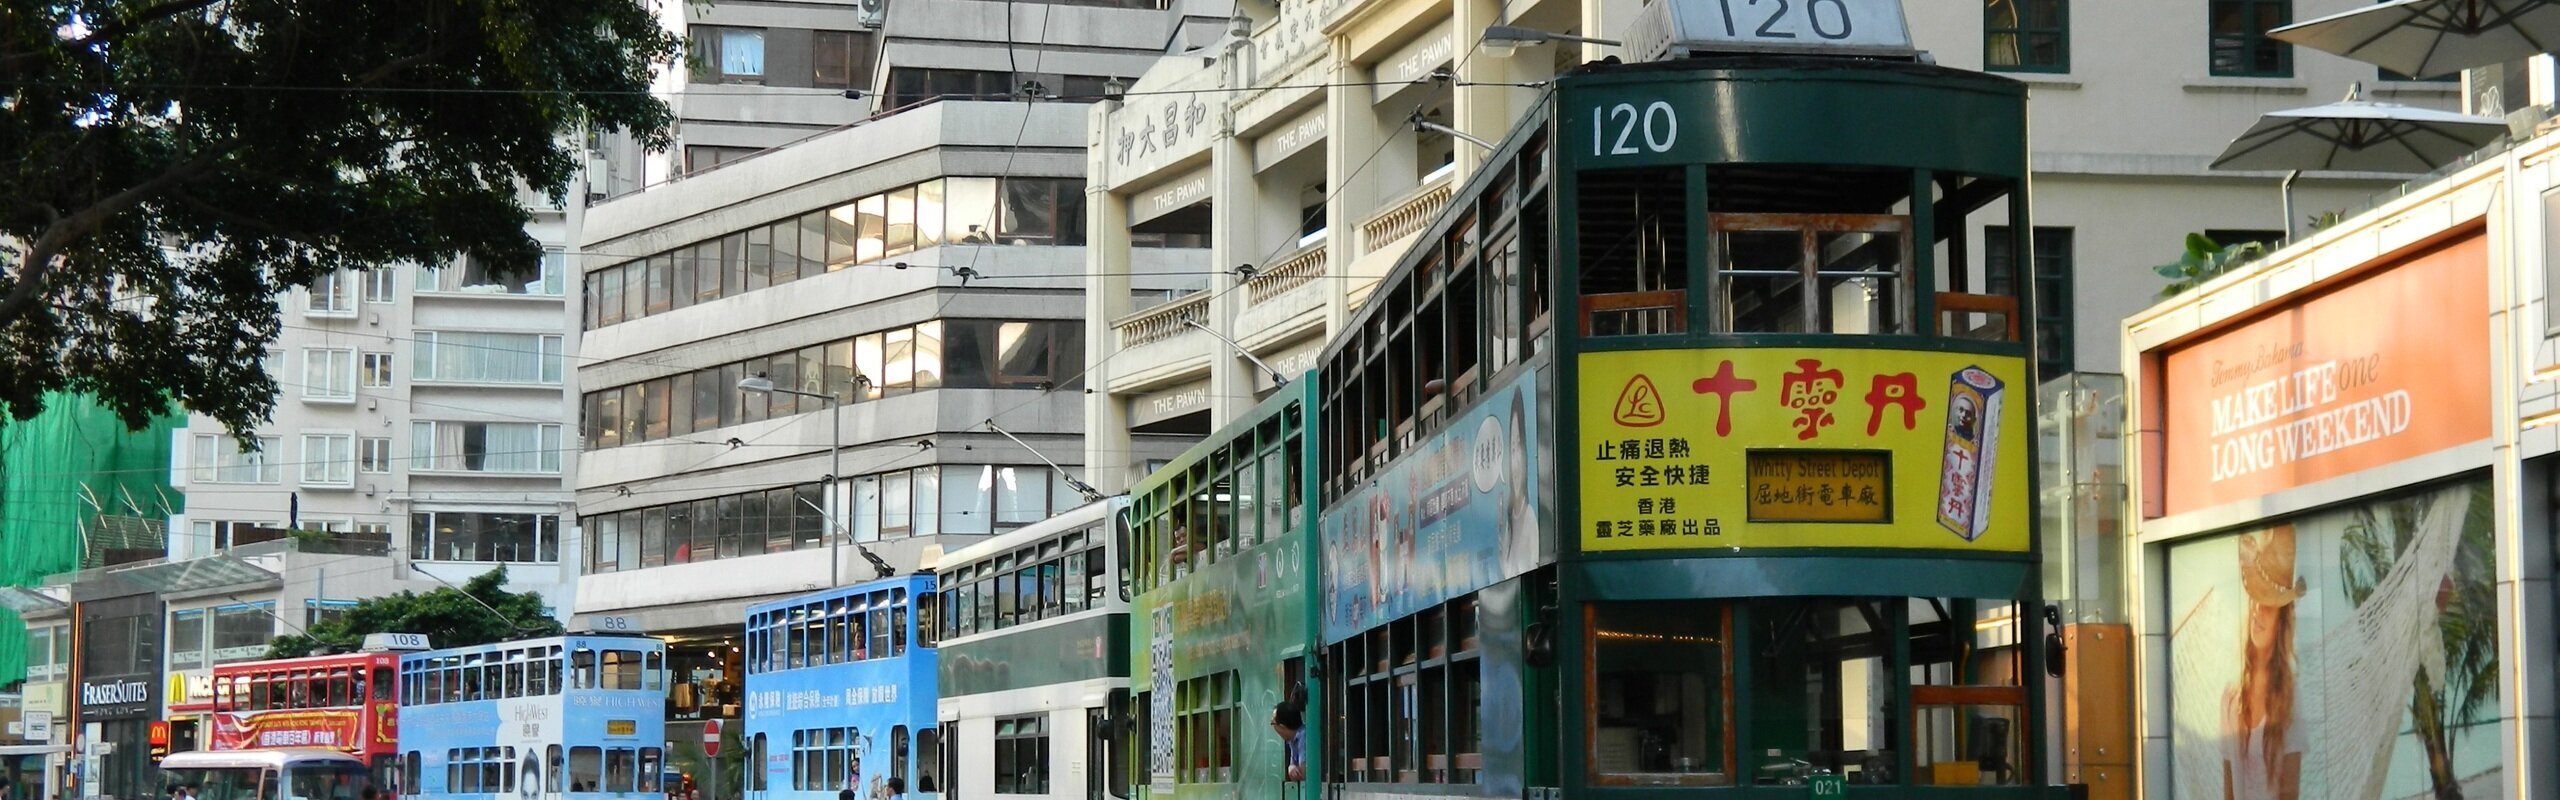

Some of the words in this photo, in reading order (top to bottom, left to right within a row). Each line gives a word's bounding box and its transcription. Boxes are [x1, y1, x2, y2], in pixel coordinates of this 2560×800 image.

[1398, 53, 1418, 80] THE
[1421, 33, 1451, 67] PAWN
[1277, 130, 1296, 153] THE
[1299, 113, 1325, 142] PAWN
[1593, 101, 1677, 156] 120
[1153, 190, 1174, 211] THE
[1177, 177, 1205, 202] PAWN
[1277, 356, 1296, 375] THE
[2211, 360, 2251, 388] Tommy
[2252, 342, 2304, 373] Bahama
[1153, 396, 1174, 415] THE
[1176, 387, 1205, 409] PAWN
[2211, 380, 2278, 437] MAKE
[2278, 360, 2337, 416] LIFE
[2339, 352, 2380, 391] one
[2211, 429, 2275, 482] LONG
[2275, 389, 2411, 464] WEEKEND
[1596, 438, 1690, 460] 止痛退熱
[1616, 465, 1710, 487] 安全快捷
[1753, 458, 1793, 481] Whitty
[1799, 457, 1837, 478] Street
[1842, 457, 1880, 479] Depot
[1638, 498, 1676, 514] 香港
[1755, 483, 1879, 508] 屈地街電車廠
[1596, 519, 1720, 538] 靈芝藥廠出品
[605, 617, 627, 629] 88
[392, 634, 420, 646] 108
[1815, 781, 1841, 795] 021
